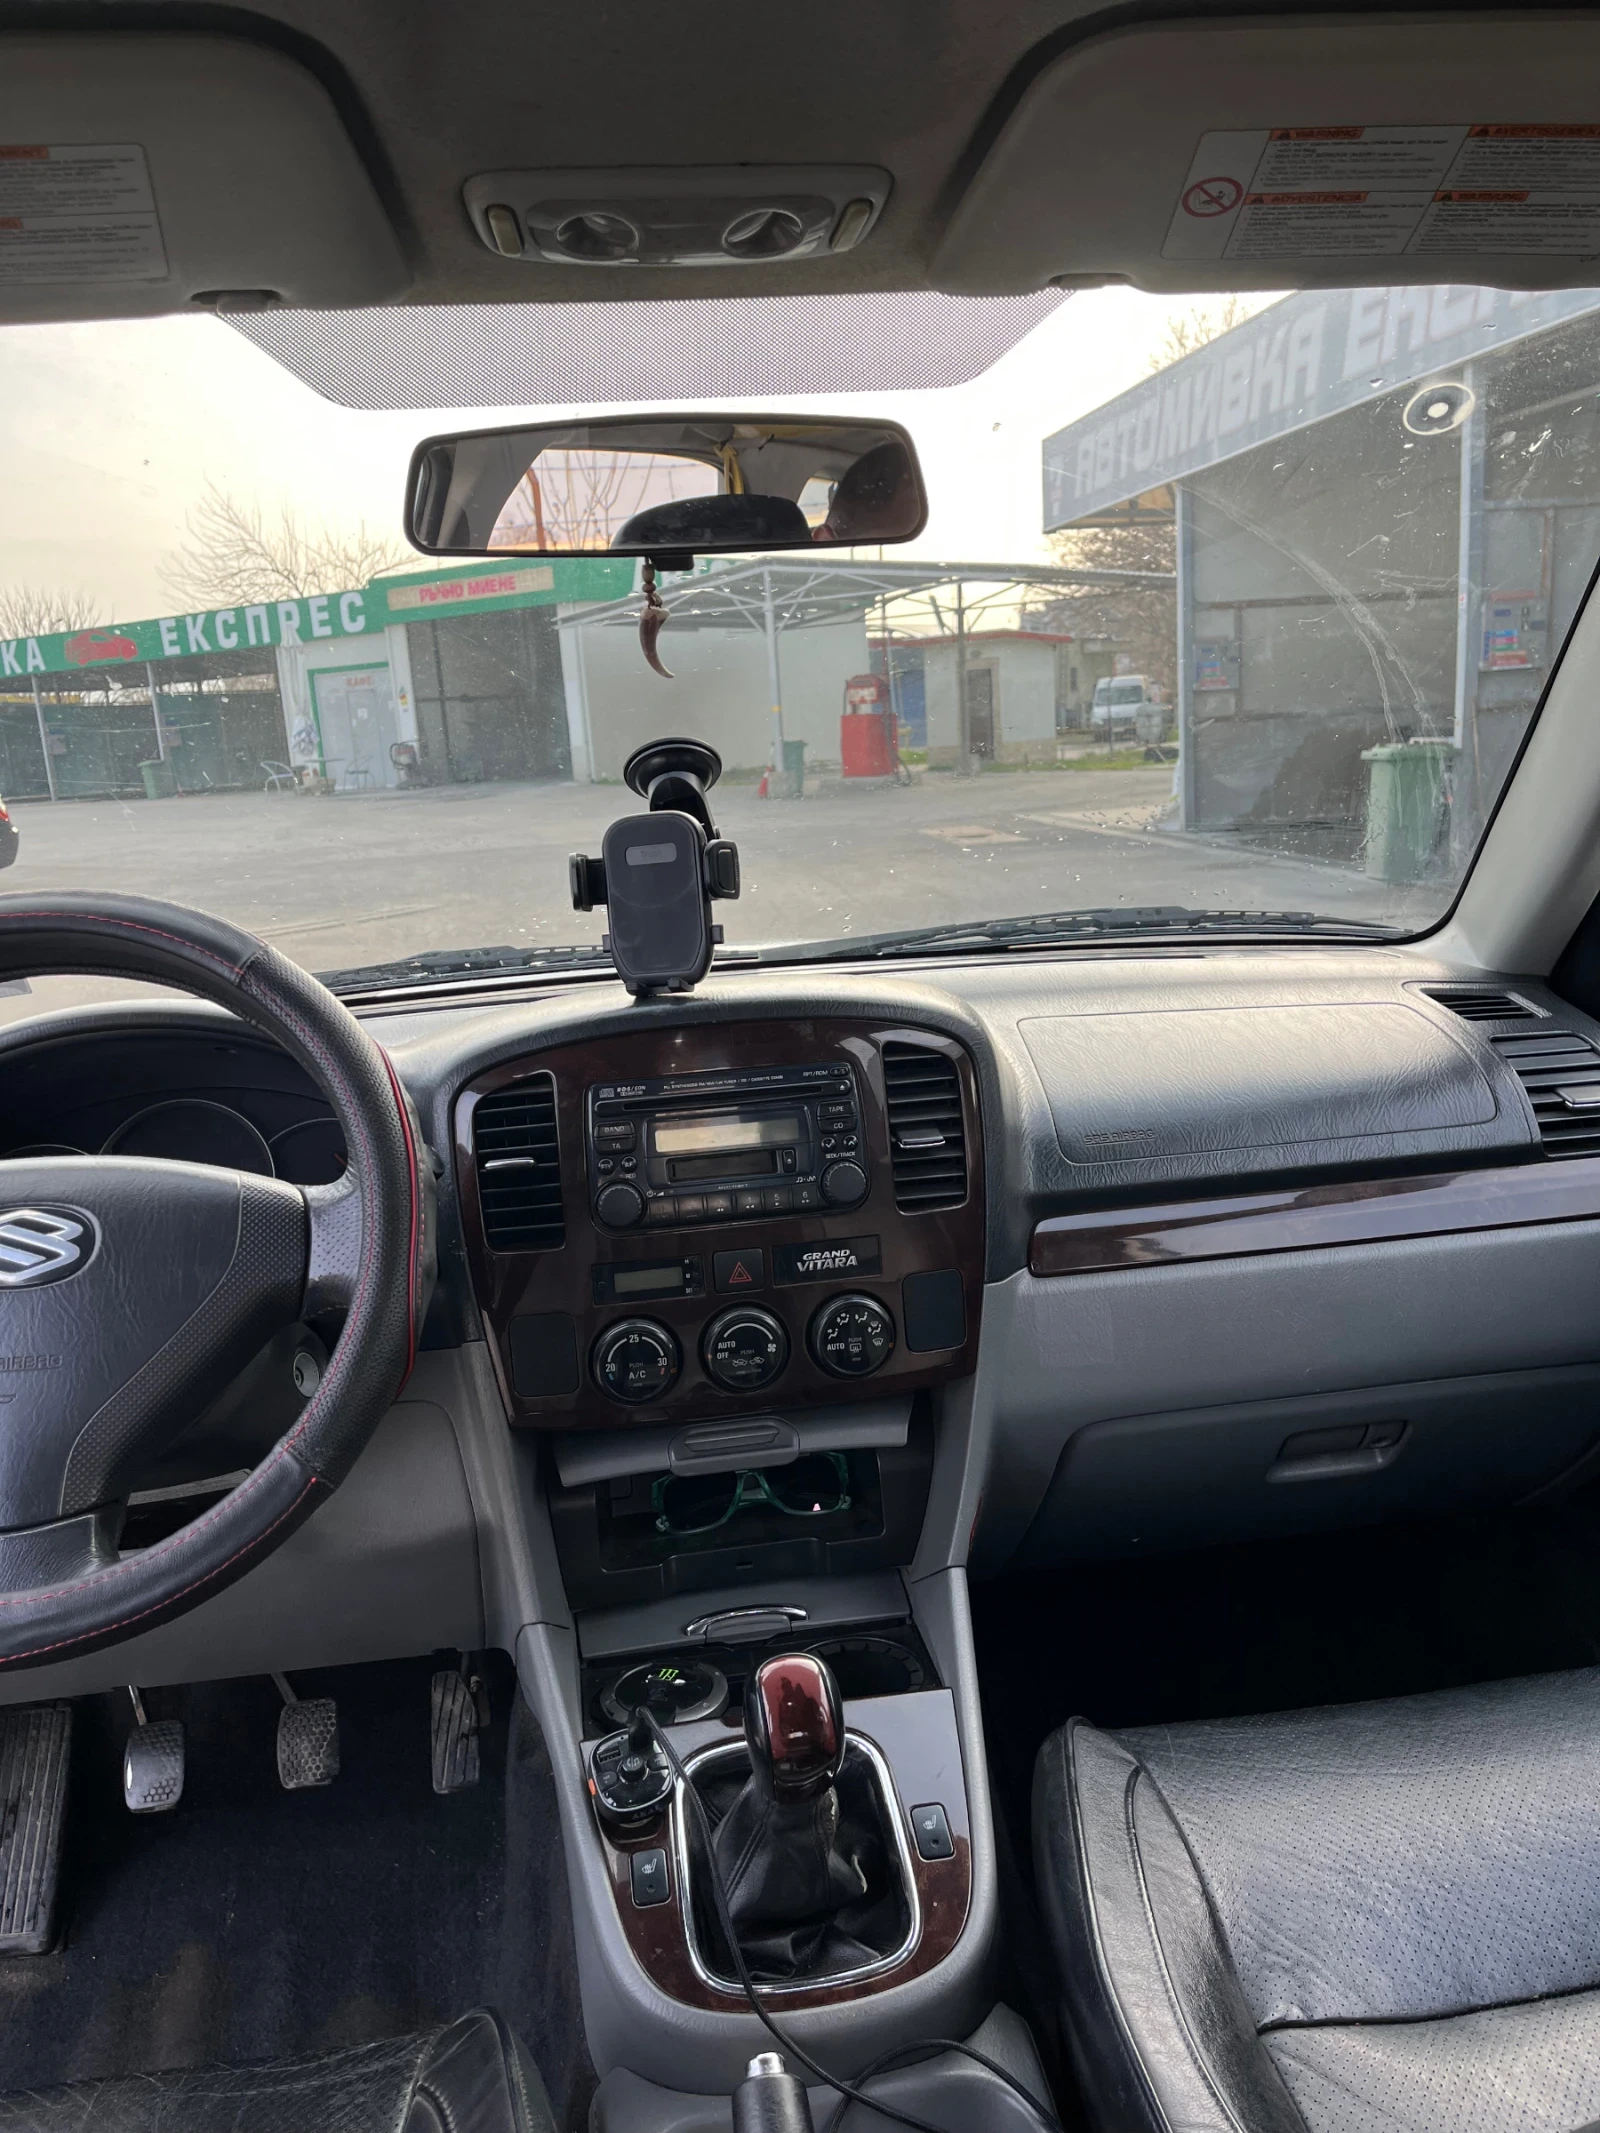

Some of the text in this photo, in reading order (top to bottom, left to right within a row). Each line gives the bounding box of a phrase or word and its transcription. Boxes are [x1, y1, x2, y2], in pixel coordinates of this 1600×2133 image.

[1074, 302, 1327, 500] АВТОМИВКА
[467, 576, 517, 596] МИЕНЕ
[158, 591, 366, 656] ЕКСПРЕС
[1084, 1129, 1155, 1145] SRS AIRBAG
[825, 1151, 856, 1159] SEEK/TRACK
[774, 1193, 780, 1201] 5
[802, 1191, 808, 1199] 6
[802, 1249, 851, 1261] GRAND
[796, 1255, 858, 1272] VITARA
[628, 1334, 640, 1343] 25
[717, 1340, 736, 1349] AUTO
[826, 1342, 845, 1351] AUTO
[657, 1357, 668, 1366] 30
[605, 1363, 616, 1372] 20
[628, 1370, 646, 1380] A/C
